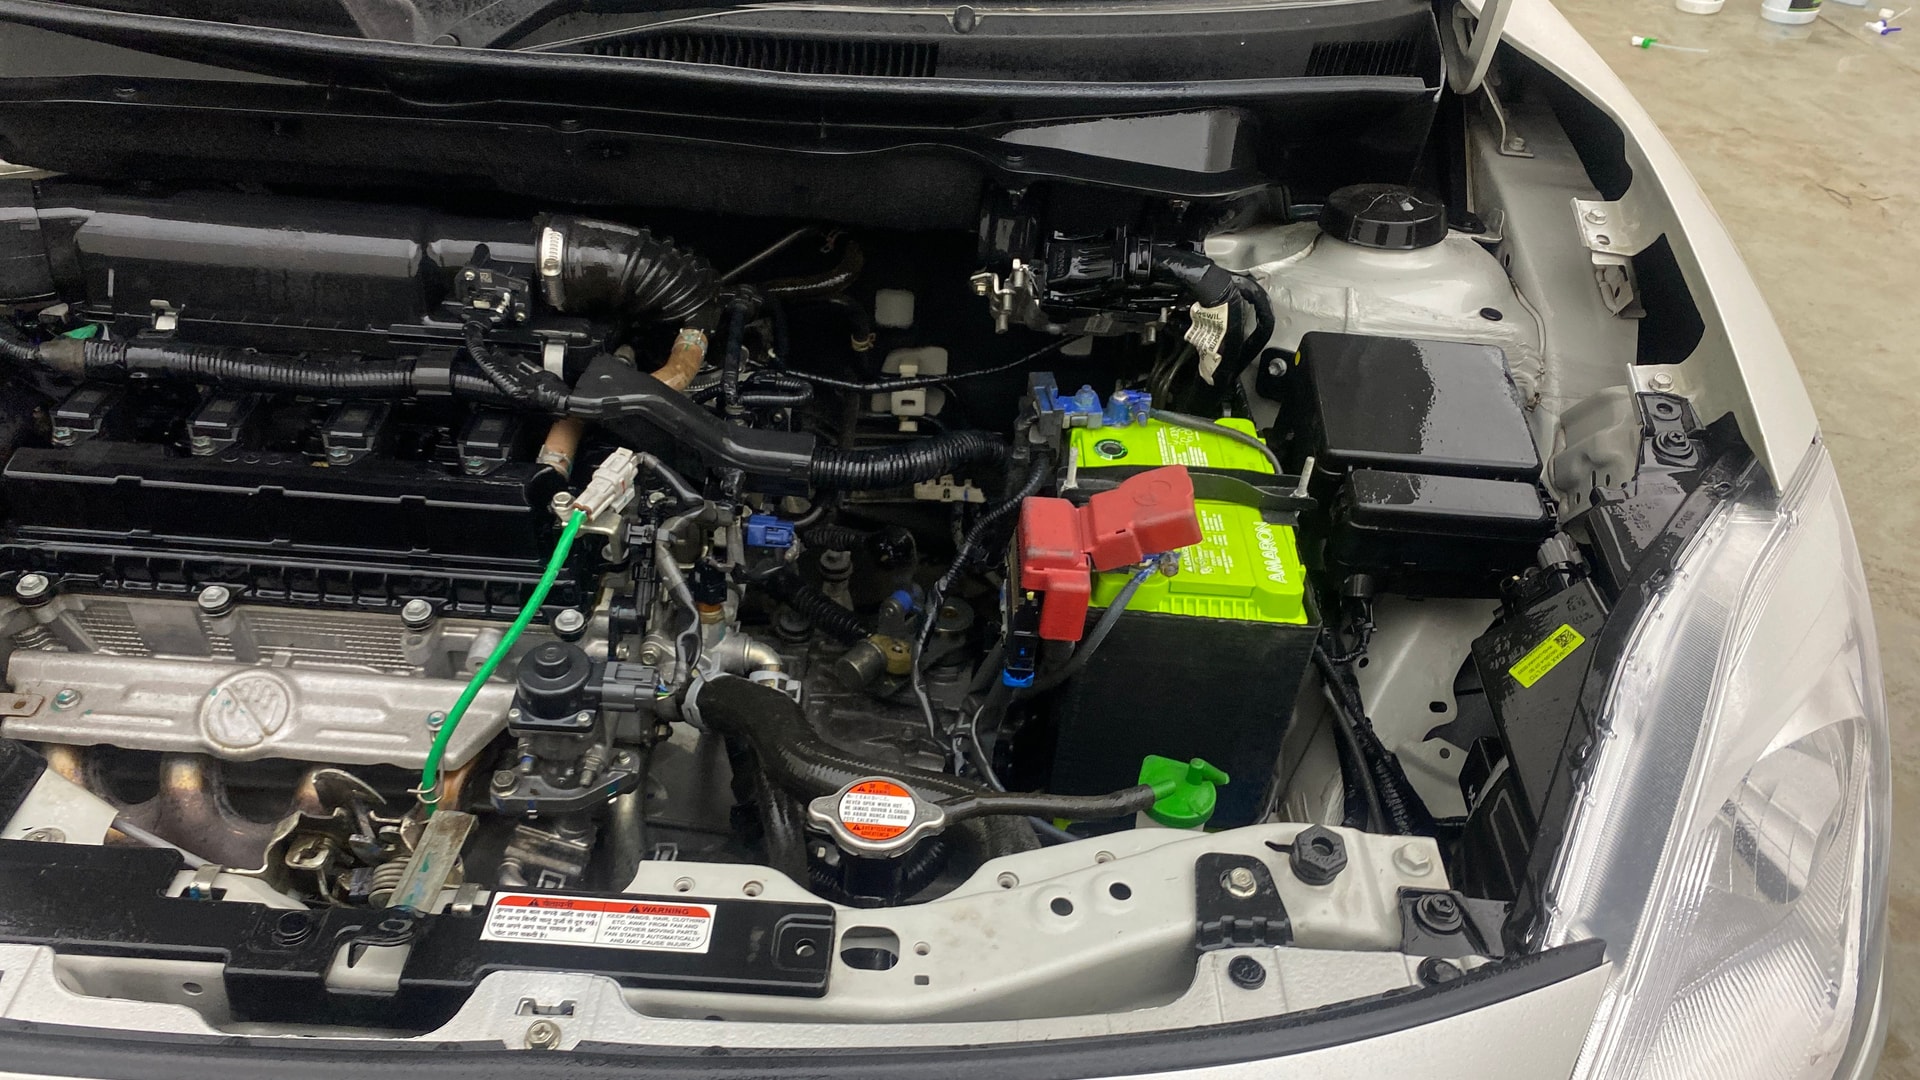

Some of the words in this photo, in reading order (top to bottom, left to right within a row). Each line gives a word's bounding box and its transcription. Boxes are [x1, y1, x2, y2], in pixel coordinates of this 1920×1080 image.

[1253, 521, 1288, 584] AMARON
[642, 906, 689, 915] WARNING
[646, 933, 701, 942] AUTOMATICALLY
